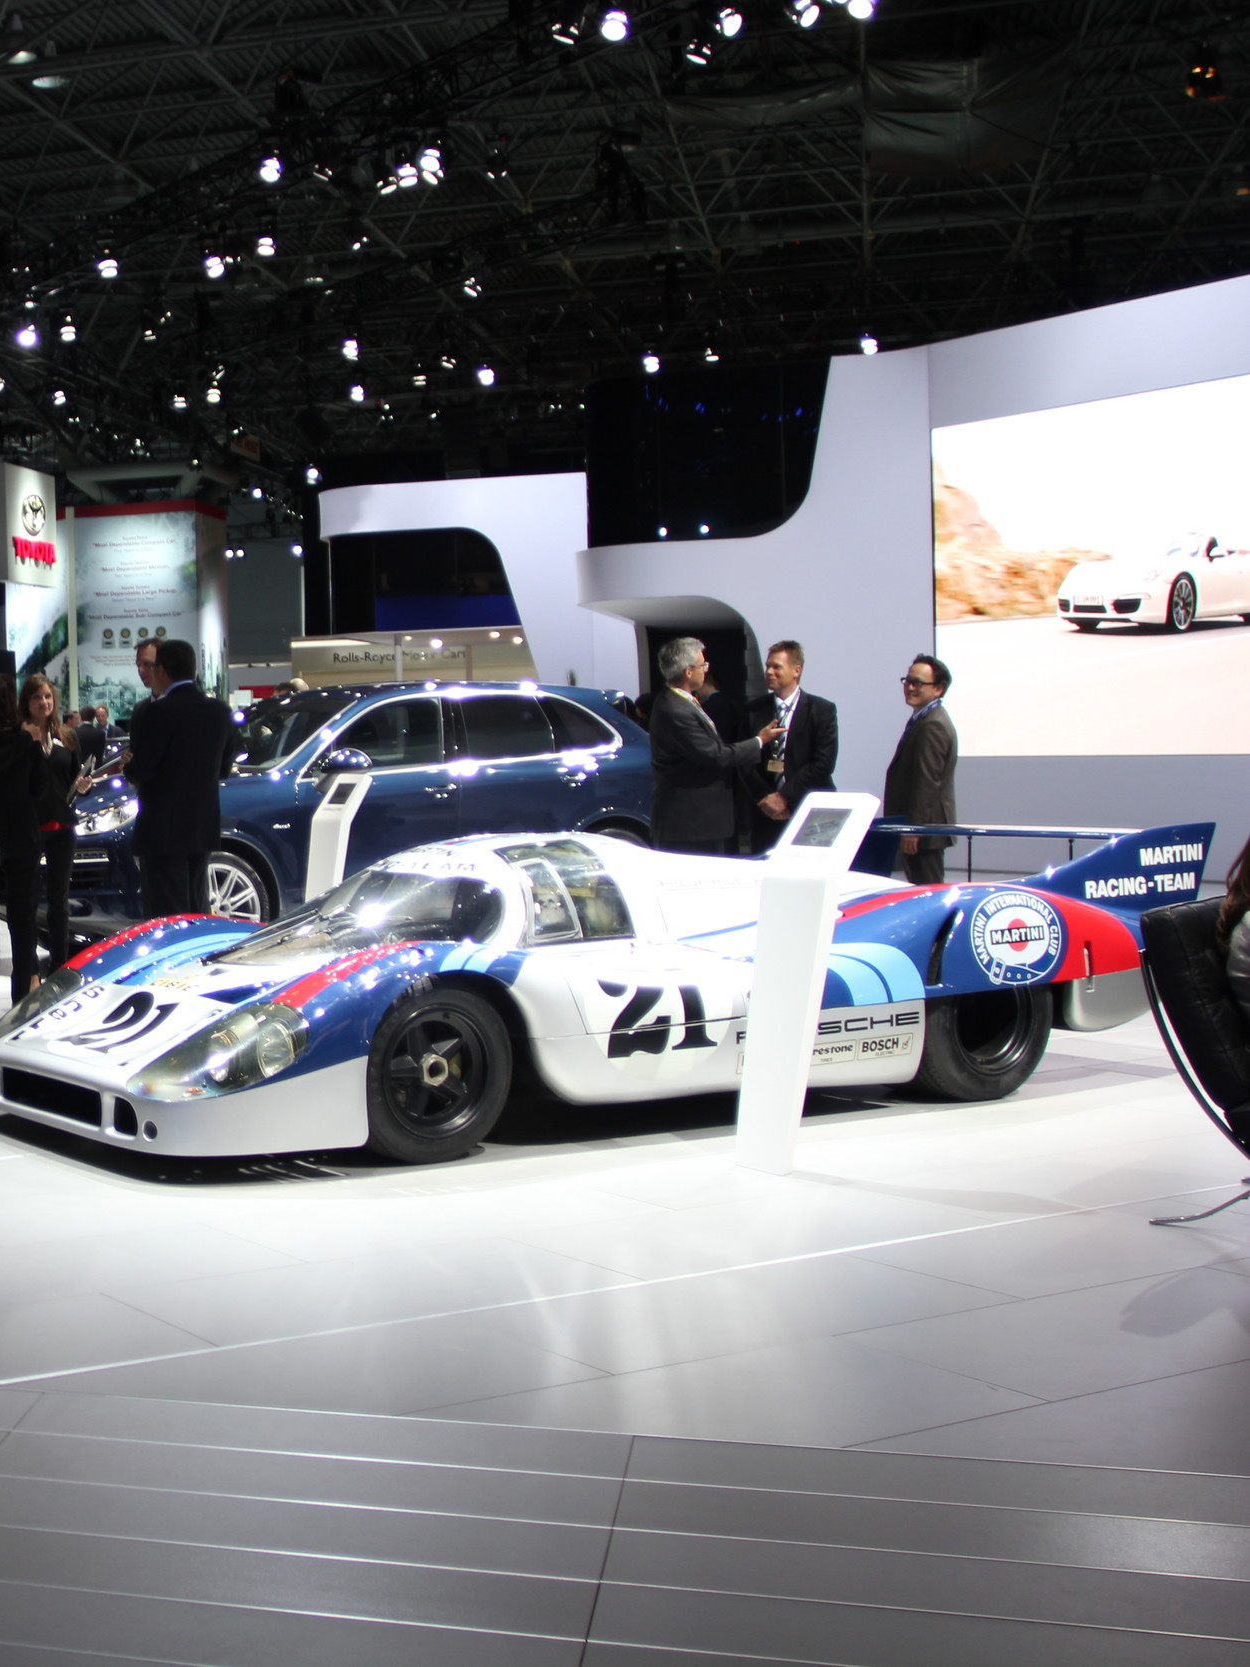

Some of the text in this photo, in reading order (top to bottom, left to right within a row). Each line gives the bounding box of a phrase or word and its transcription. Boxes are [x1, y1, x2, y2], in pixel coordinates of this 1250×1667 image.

[12, 536, 56, 563] TOYOTA
[1139, 842, 1204, 867] MARTINI
[1085, 872, 1196, 900] RACING-TEAM
[973, 894, 1060, 964] MARTINI INTERNATIONAL CLUB
[991, 925, 1044, 944] MARTINI
[56, 991, 180, 1054] 21
[597, 979, 718, 1059] 21
[813, 1044, 854, 1056] restone
[861, 1037, 899, 1053] BOSCH
